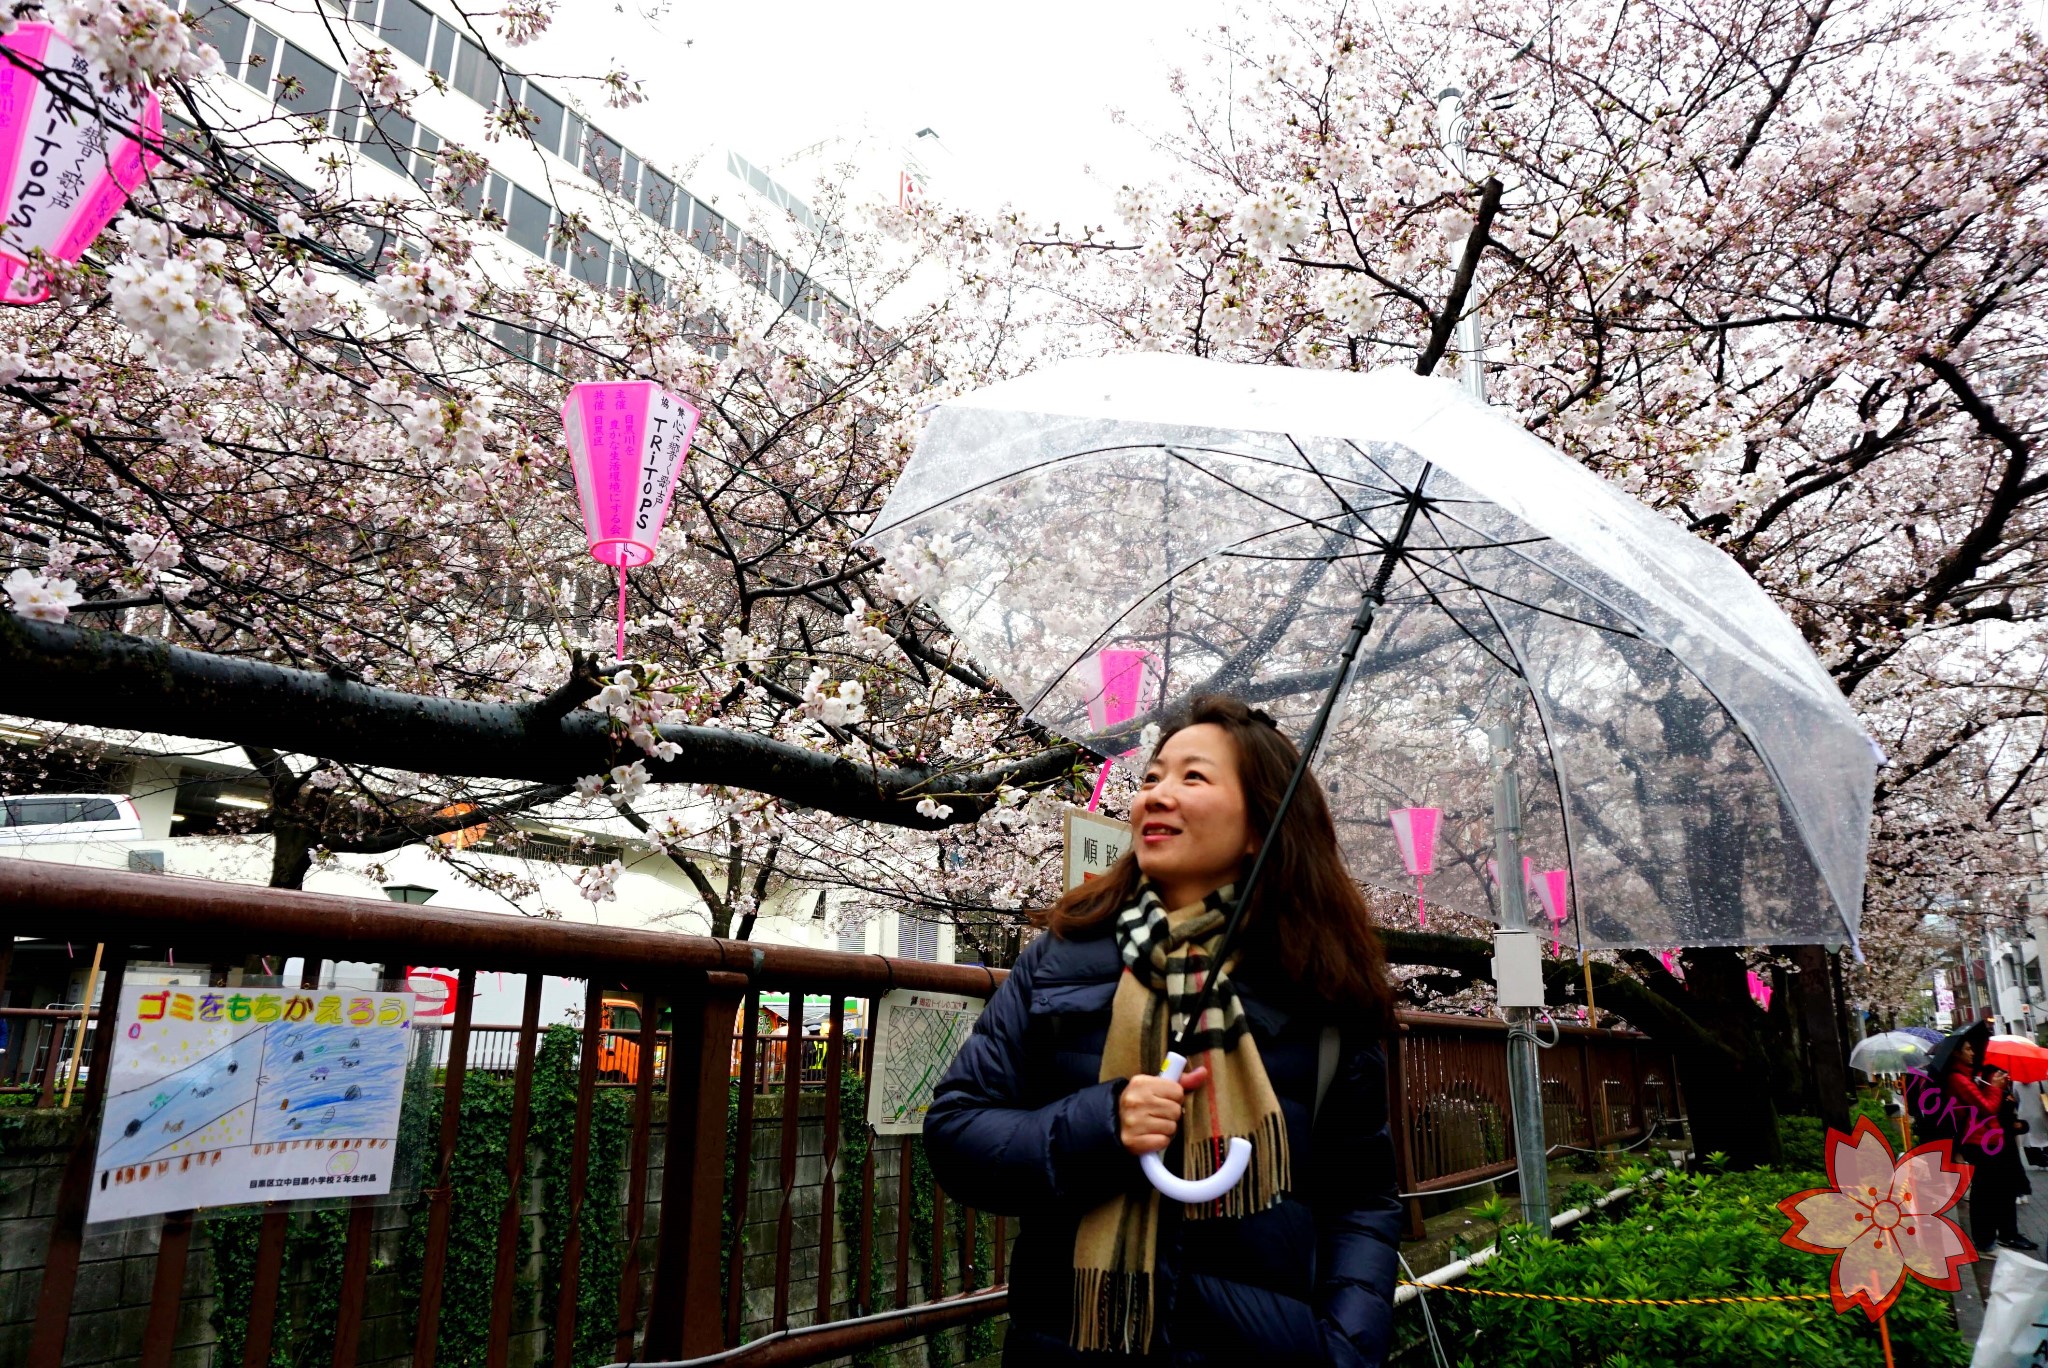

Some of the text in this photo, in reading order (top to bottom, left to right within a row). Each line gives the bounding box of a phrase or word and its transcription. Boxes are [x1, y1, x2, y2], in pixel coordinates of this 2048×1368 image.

[46, 97, 128, 209] 心響く歌声
[137, 990, 405, 1026] ゴミをもちかえろう
